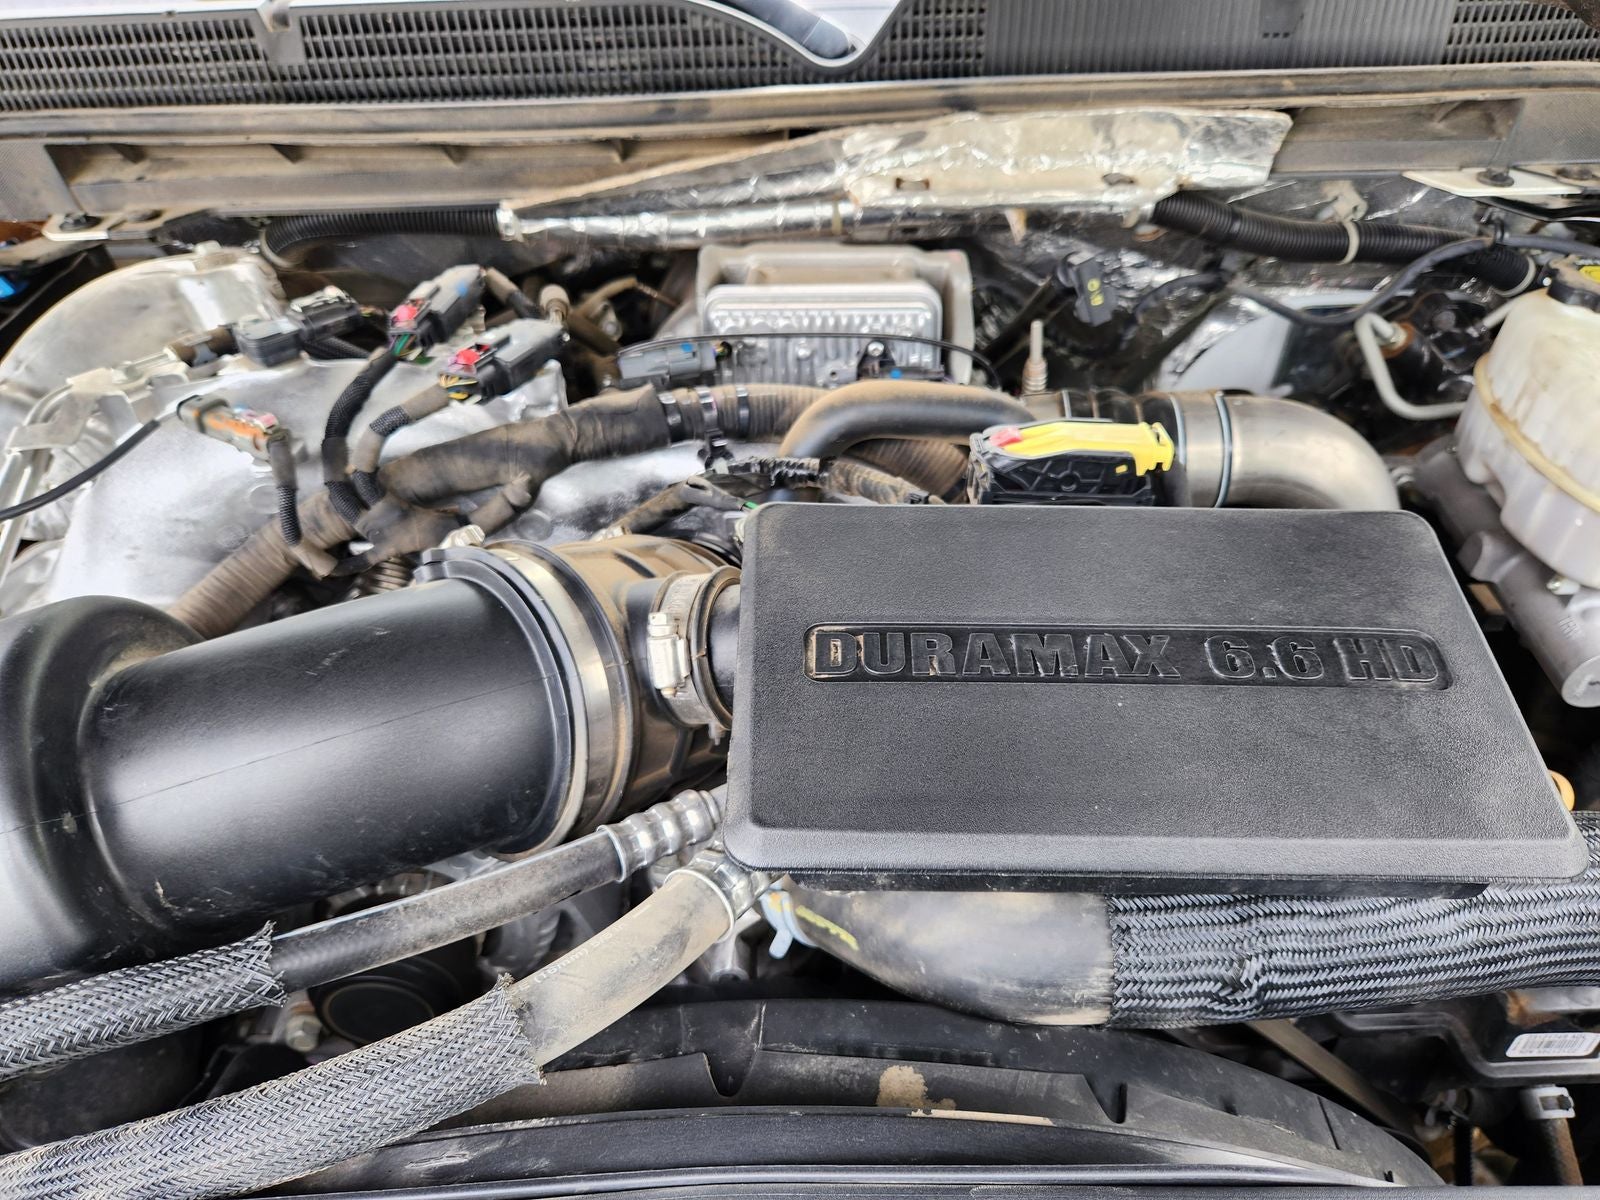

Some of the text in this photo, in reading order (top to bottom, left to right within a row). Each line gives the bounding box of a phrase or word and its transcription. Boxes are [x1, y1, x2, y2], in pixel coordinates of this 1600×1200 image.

[813, 632, 1438, 683] DURAMAX 6.6 HD
